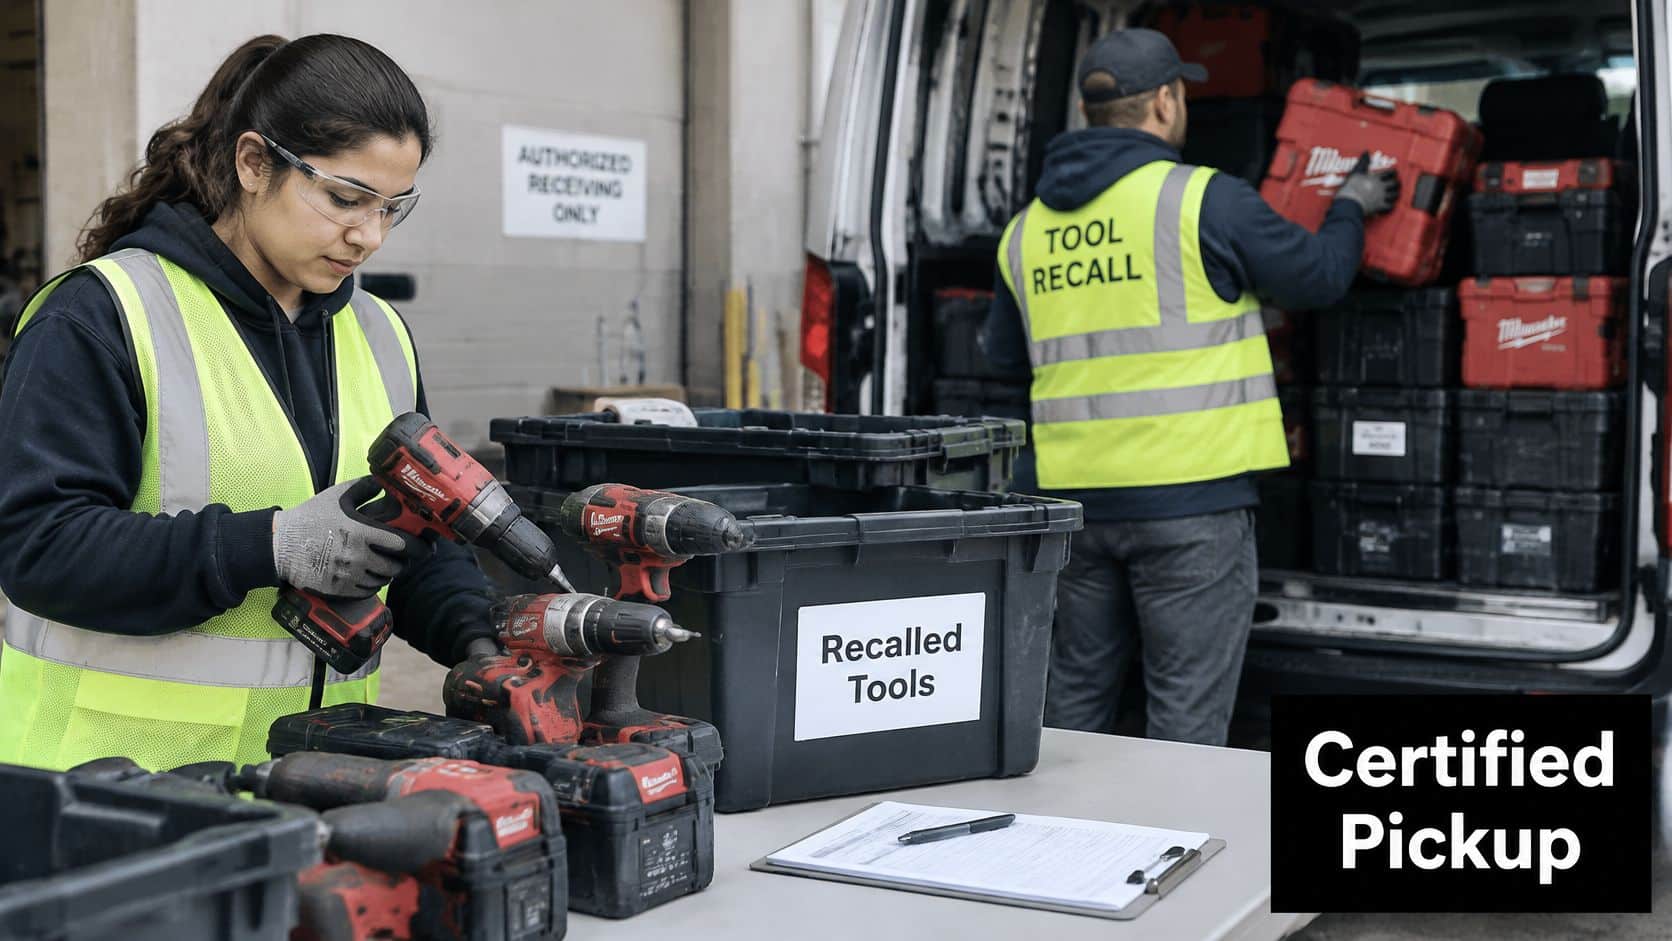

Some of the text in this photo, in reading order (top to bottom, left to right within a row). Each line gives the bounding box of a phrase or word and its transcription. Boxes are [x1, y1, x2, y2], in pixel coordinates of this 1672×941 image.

[518, 146, 632, 174] AUTHORIZED
[528, 174, 623, 199] RECEIVING
[552, 202, 601, 225] ONLY
[1044, 217, 1123, 254] TOOL
[1033, 254, 1142, 295] RECALL
[821, 622, 962, 664] Recalled
[847, 668, 935, 704] Tools
